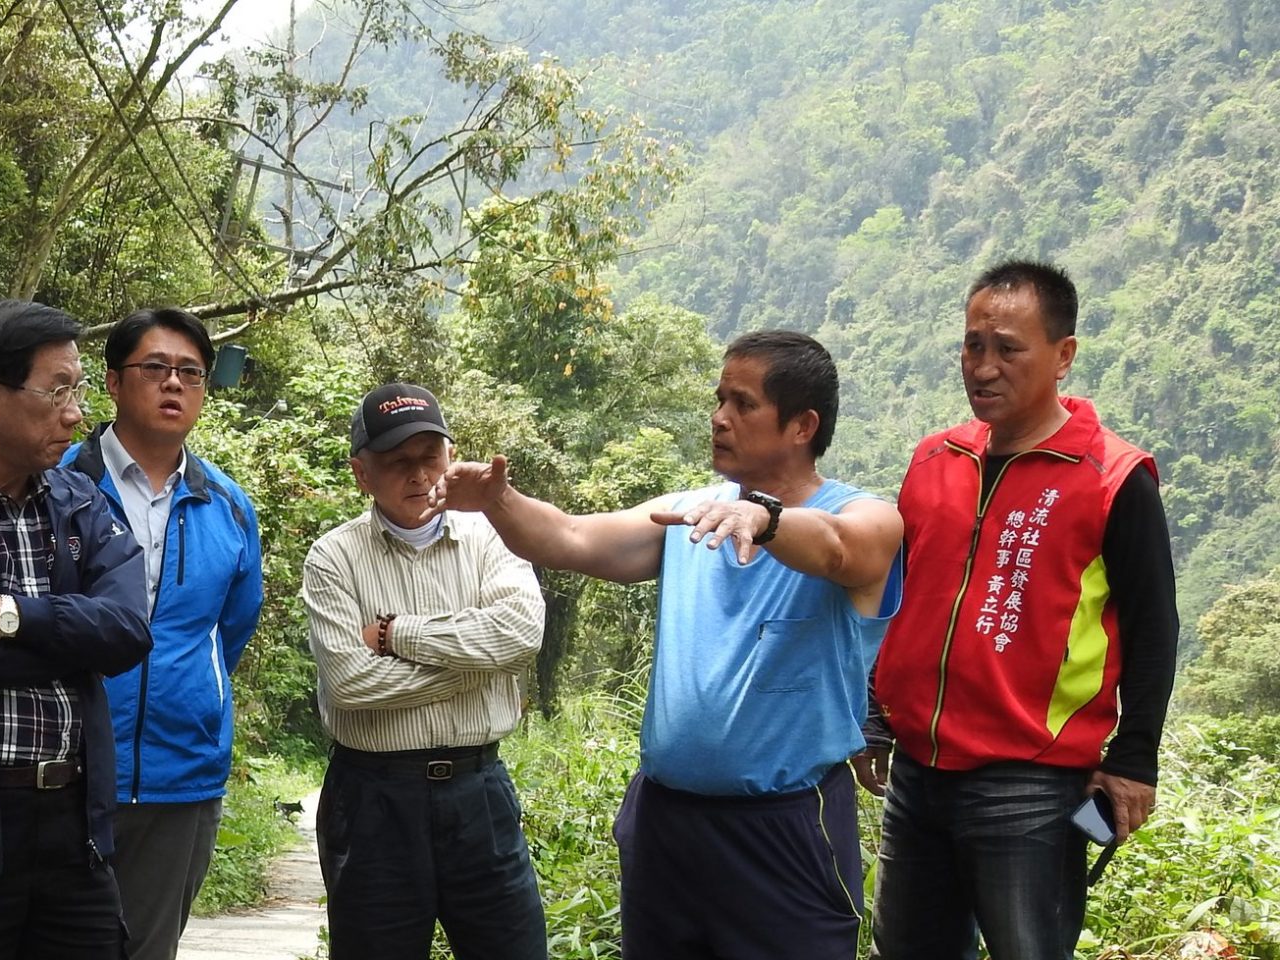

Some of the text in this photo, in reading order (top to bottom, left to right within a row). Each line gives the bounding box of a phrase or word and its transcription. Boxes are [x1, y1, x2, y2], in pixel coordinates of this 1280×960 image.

[379, 396, 430, 413] Taiwan
[975, 509, 1026, 635] 總幹事 黃立行
[993, 488, 1060, 653] 清流社區發展協會
